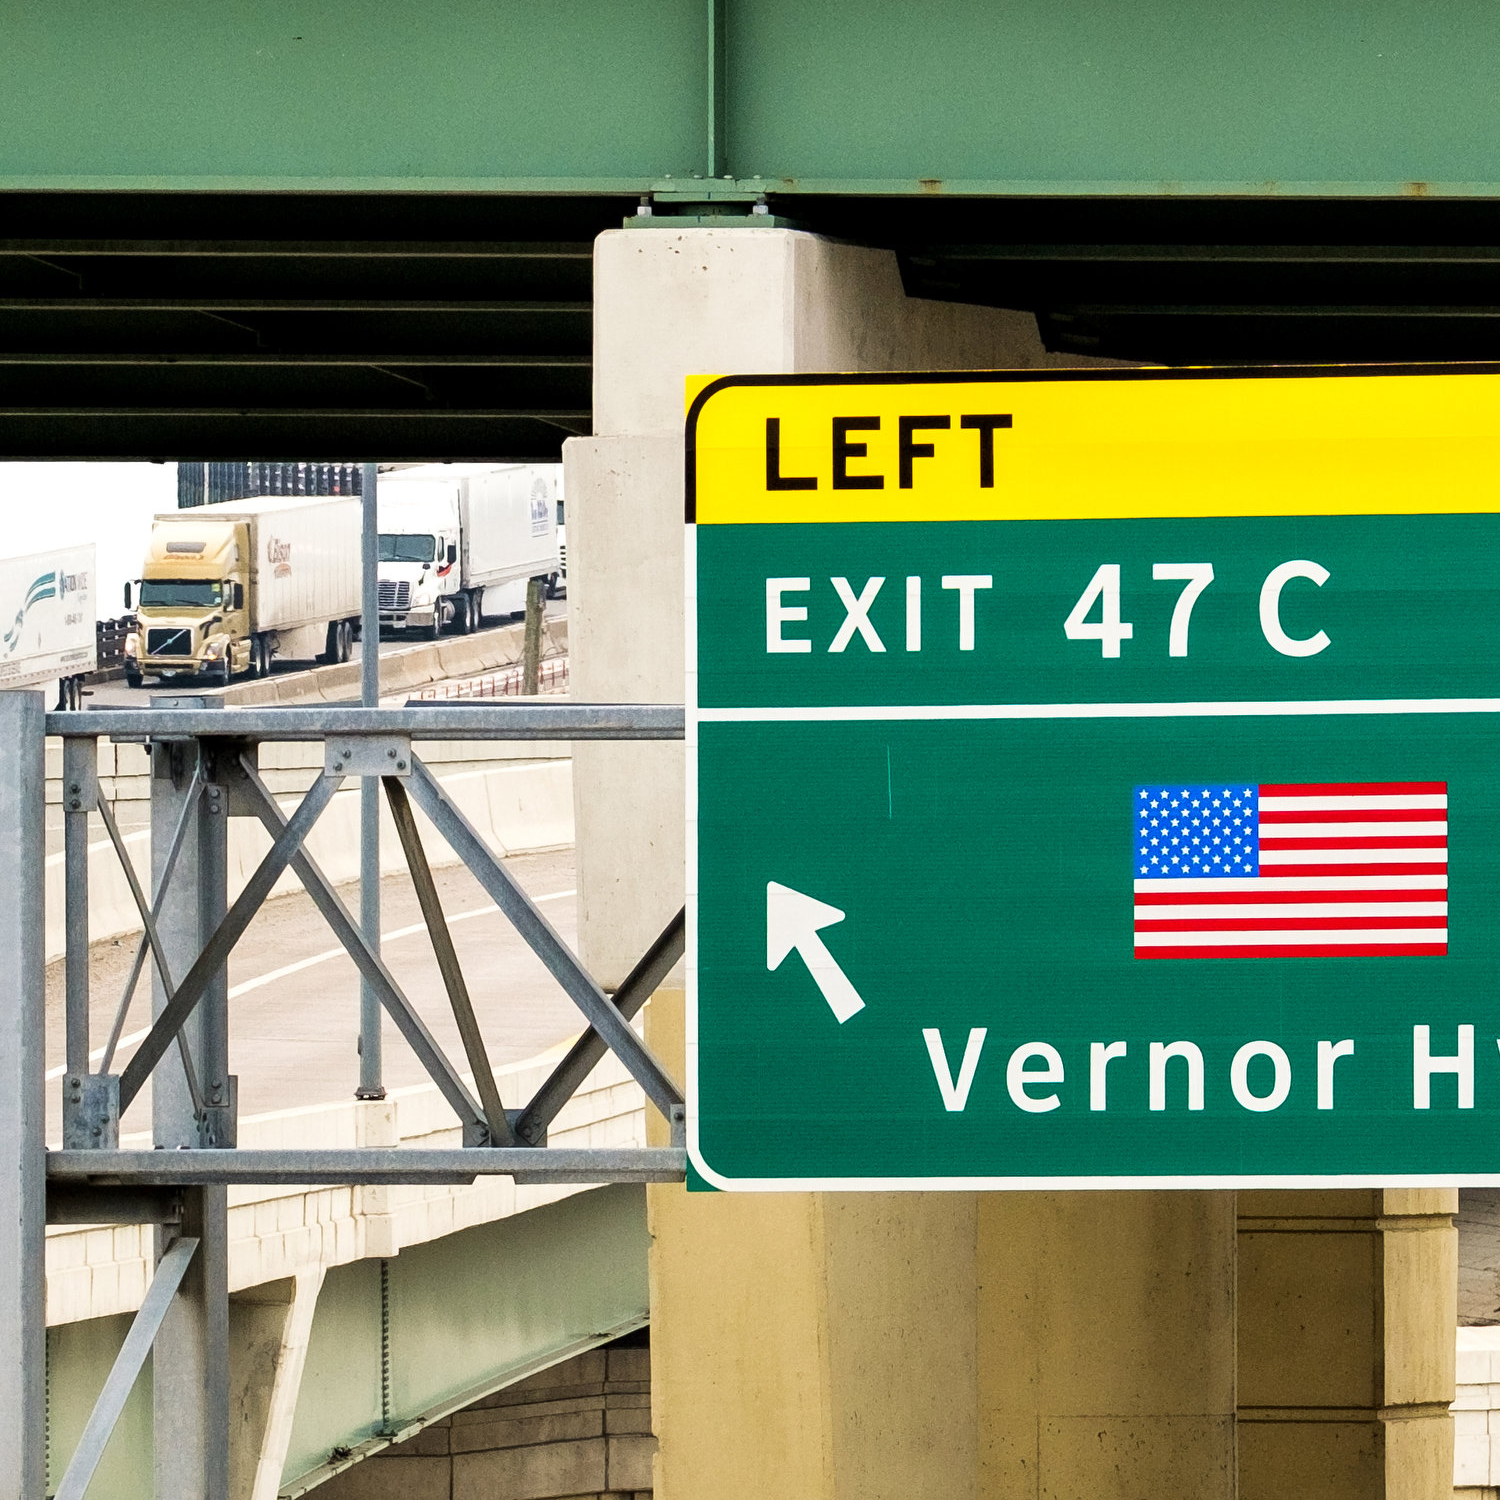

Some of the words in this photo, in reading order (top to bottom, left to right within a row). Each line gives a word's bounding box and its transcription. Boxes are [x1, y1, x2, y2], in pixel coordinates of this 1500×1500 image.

[766, 414, 1014, 491] LEFT
[765, 574, 994, 653] EXIT
[921, 1027, 1355, 1113] Vernor
